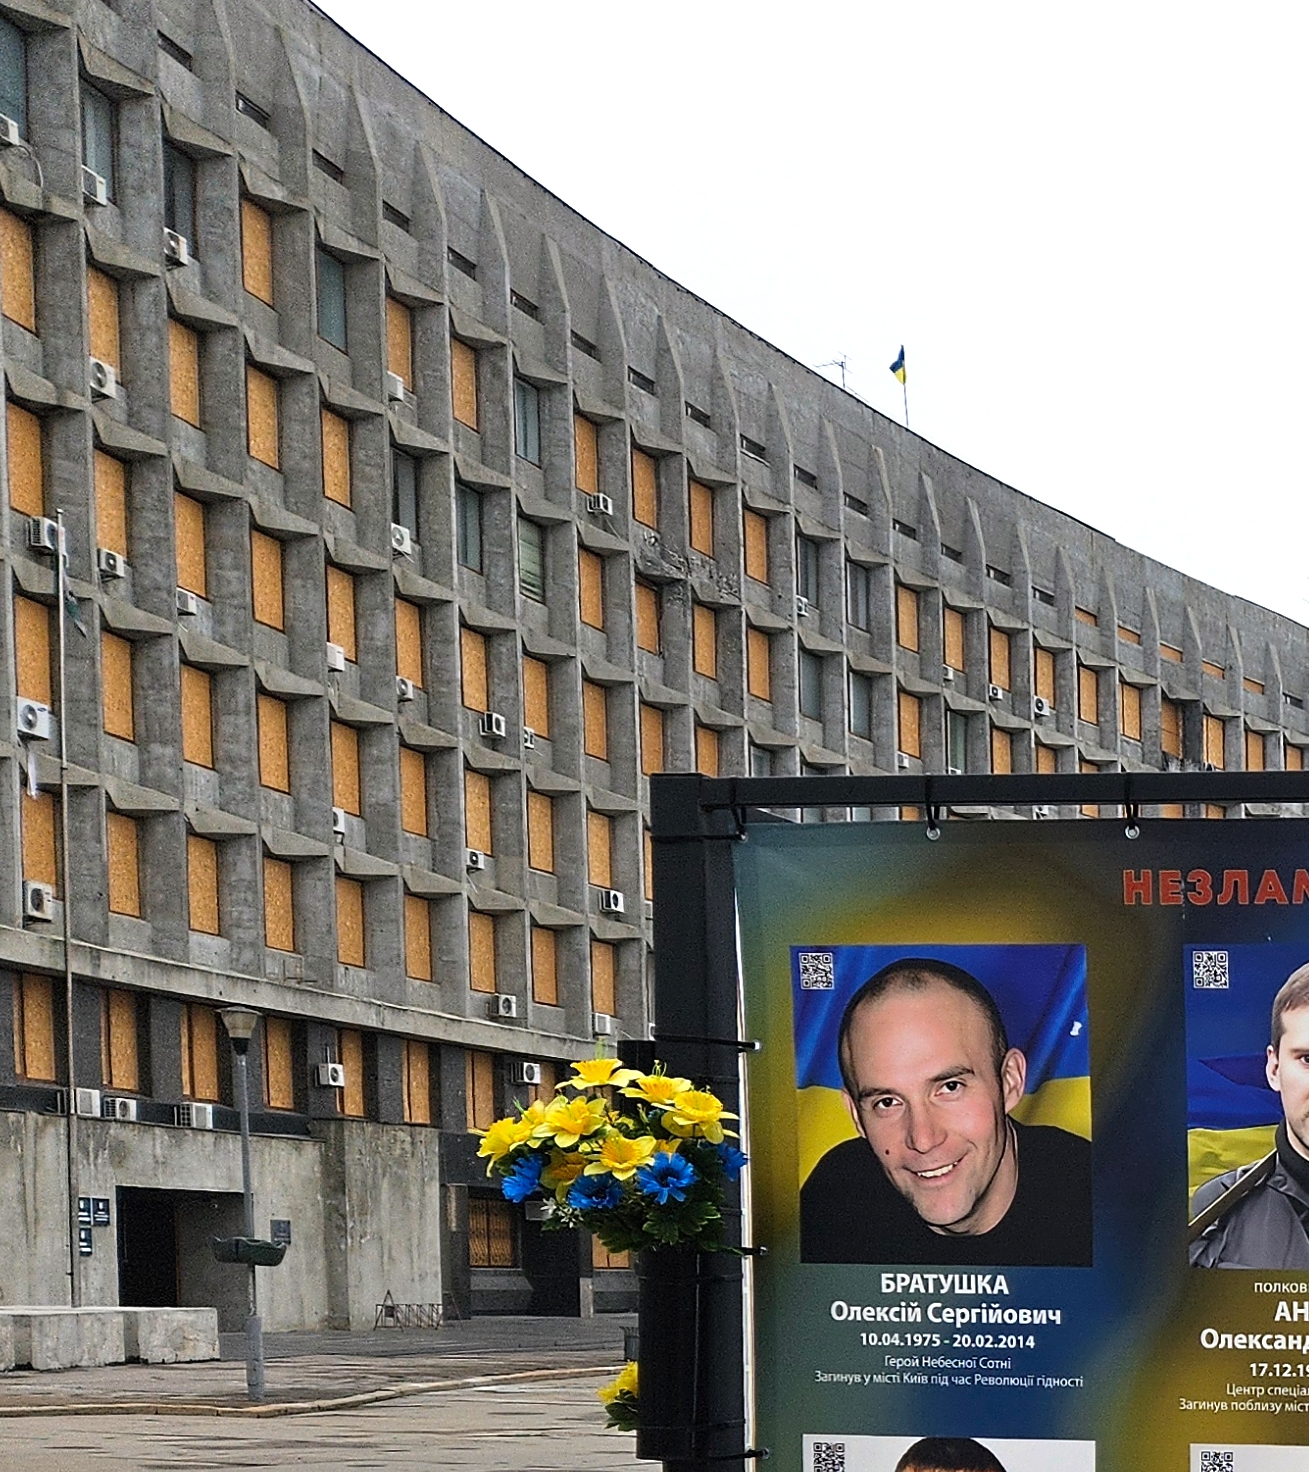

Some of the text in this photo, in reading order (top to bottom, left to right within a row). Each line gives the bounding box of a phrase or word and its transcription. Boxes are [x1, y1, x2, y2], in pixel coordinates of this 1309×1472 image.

[880, 1273, 1009, 1294] БРАТУШКА
[830, 1300, 1061, 1327] Олексій Сергійович
[860, 1332, 1035, 1348] 10.04.1975 20.02.2014
[884, 1354, 1011, 1369] Герой Небесної Сотні
[814, 1370, 1084, 1388] Загинув у місті Київ під час Революції гідності
[1226, 1383, 1265, 1398] Центр
[1179, 1397, 1229, 1413] Загинув
[1230, 1398, 1283, 1414] поблизу
